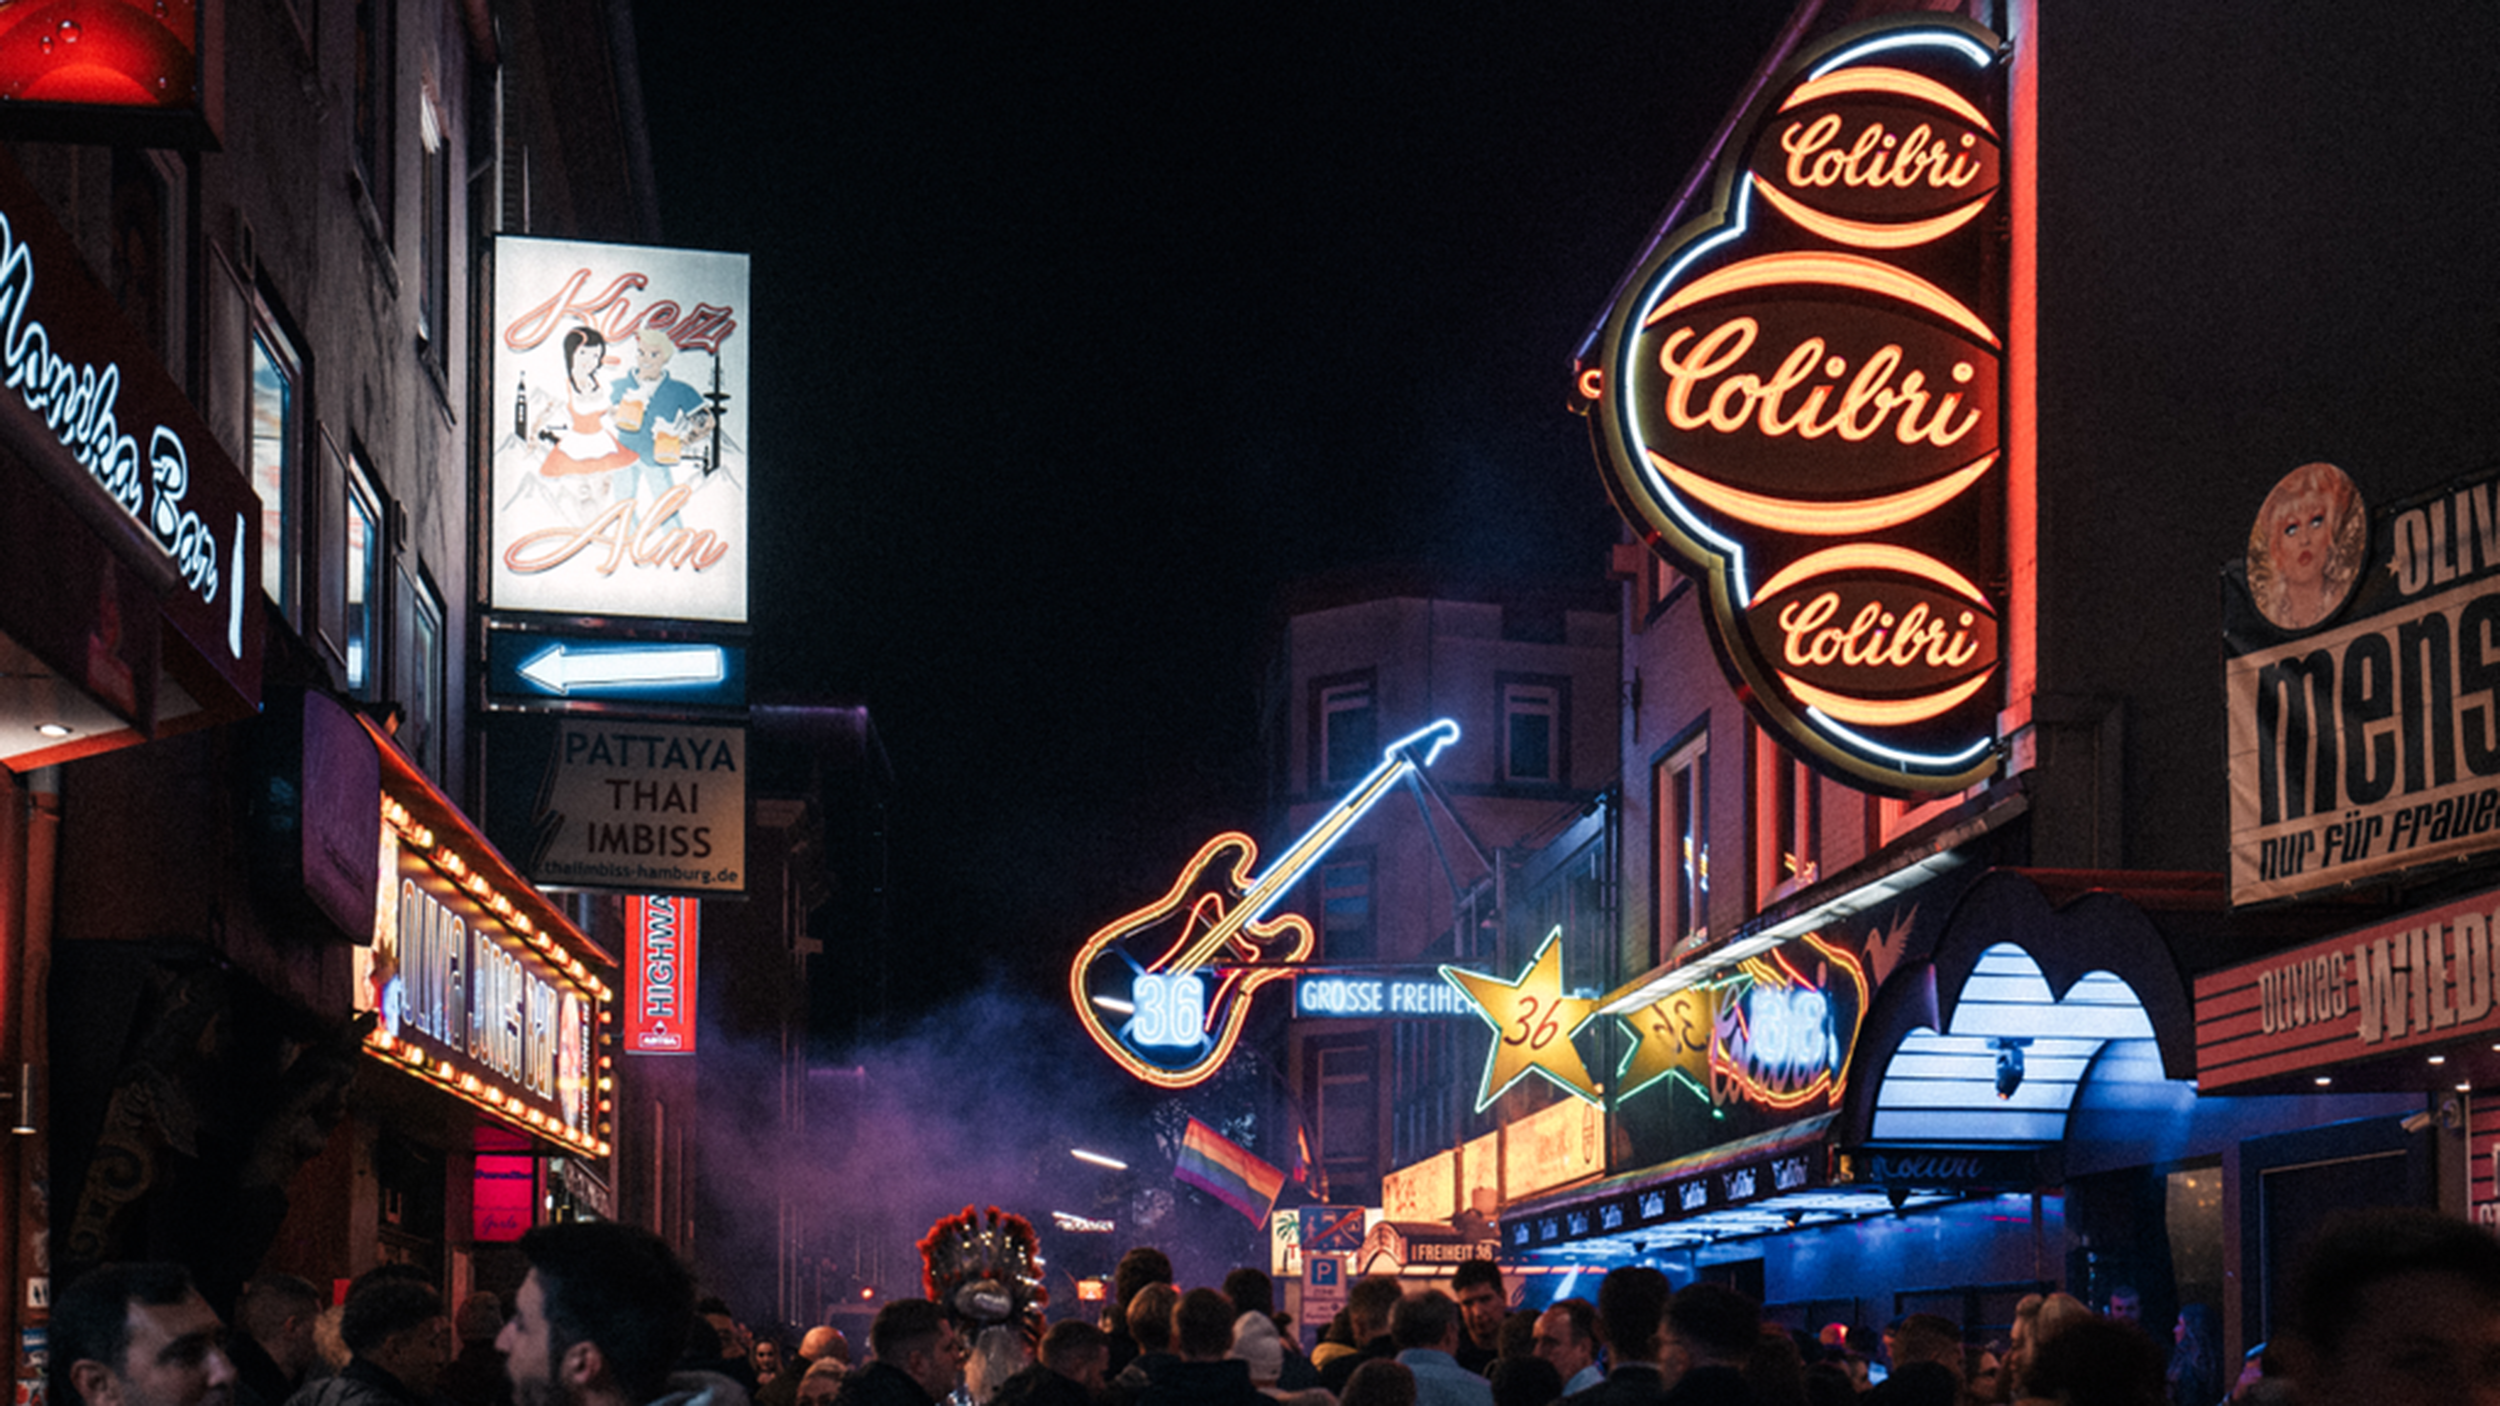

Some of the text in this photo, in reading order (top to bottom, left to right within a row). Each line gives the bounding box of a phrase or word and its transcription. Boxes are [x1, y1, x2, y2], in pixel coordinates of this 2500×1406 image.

[1781, 113, 1981, 188] Colibri
[504, 267, 737, 355] Kiez
[1658, 316, 1982, 447] Colibri
[150, 425, 217, 603] Bar
[503, 484, 730, 577] Alm
[1779, 591, 1979, 666] Colibri
[565, 732, 737, 773] PATTAYA
[605, 778, 698, 814] THAI
[587, 821, 712, 859] IMBISS
[2260, 829, 2315, 881] nur
[1135, 975, 1202, 1044] 36
[1302, 980, 1383, 1012] GROSSE
[1503, 996, 1561, 1050] 36
